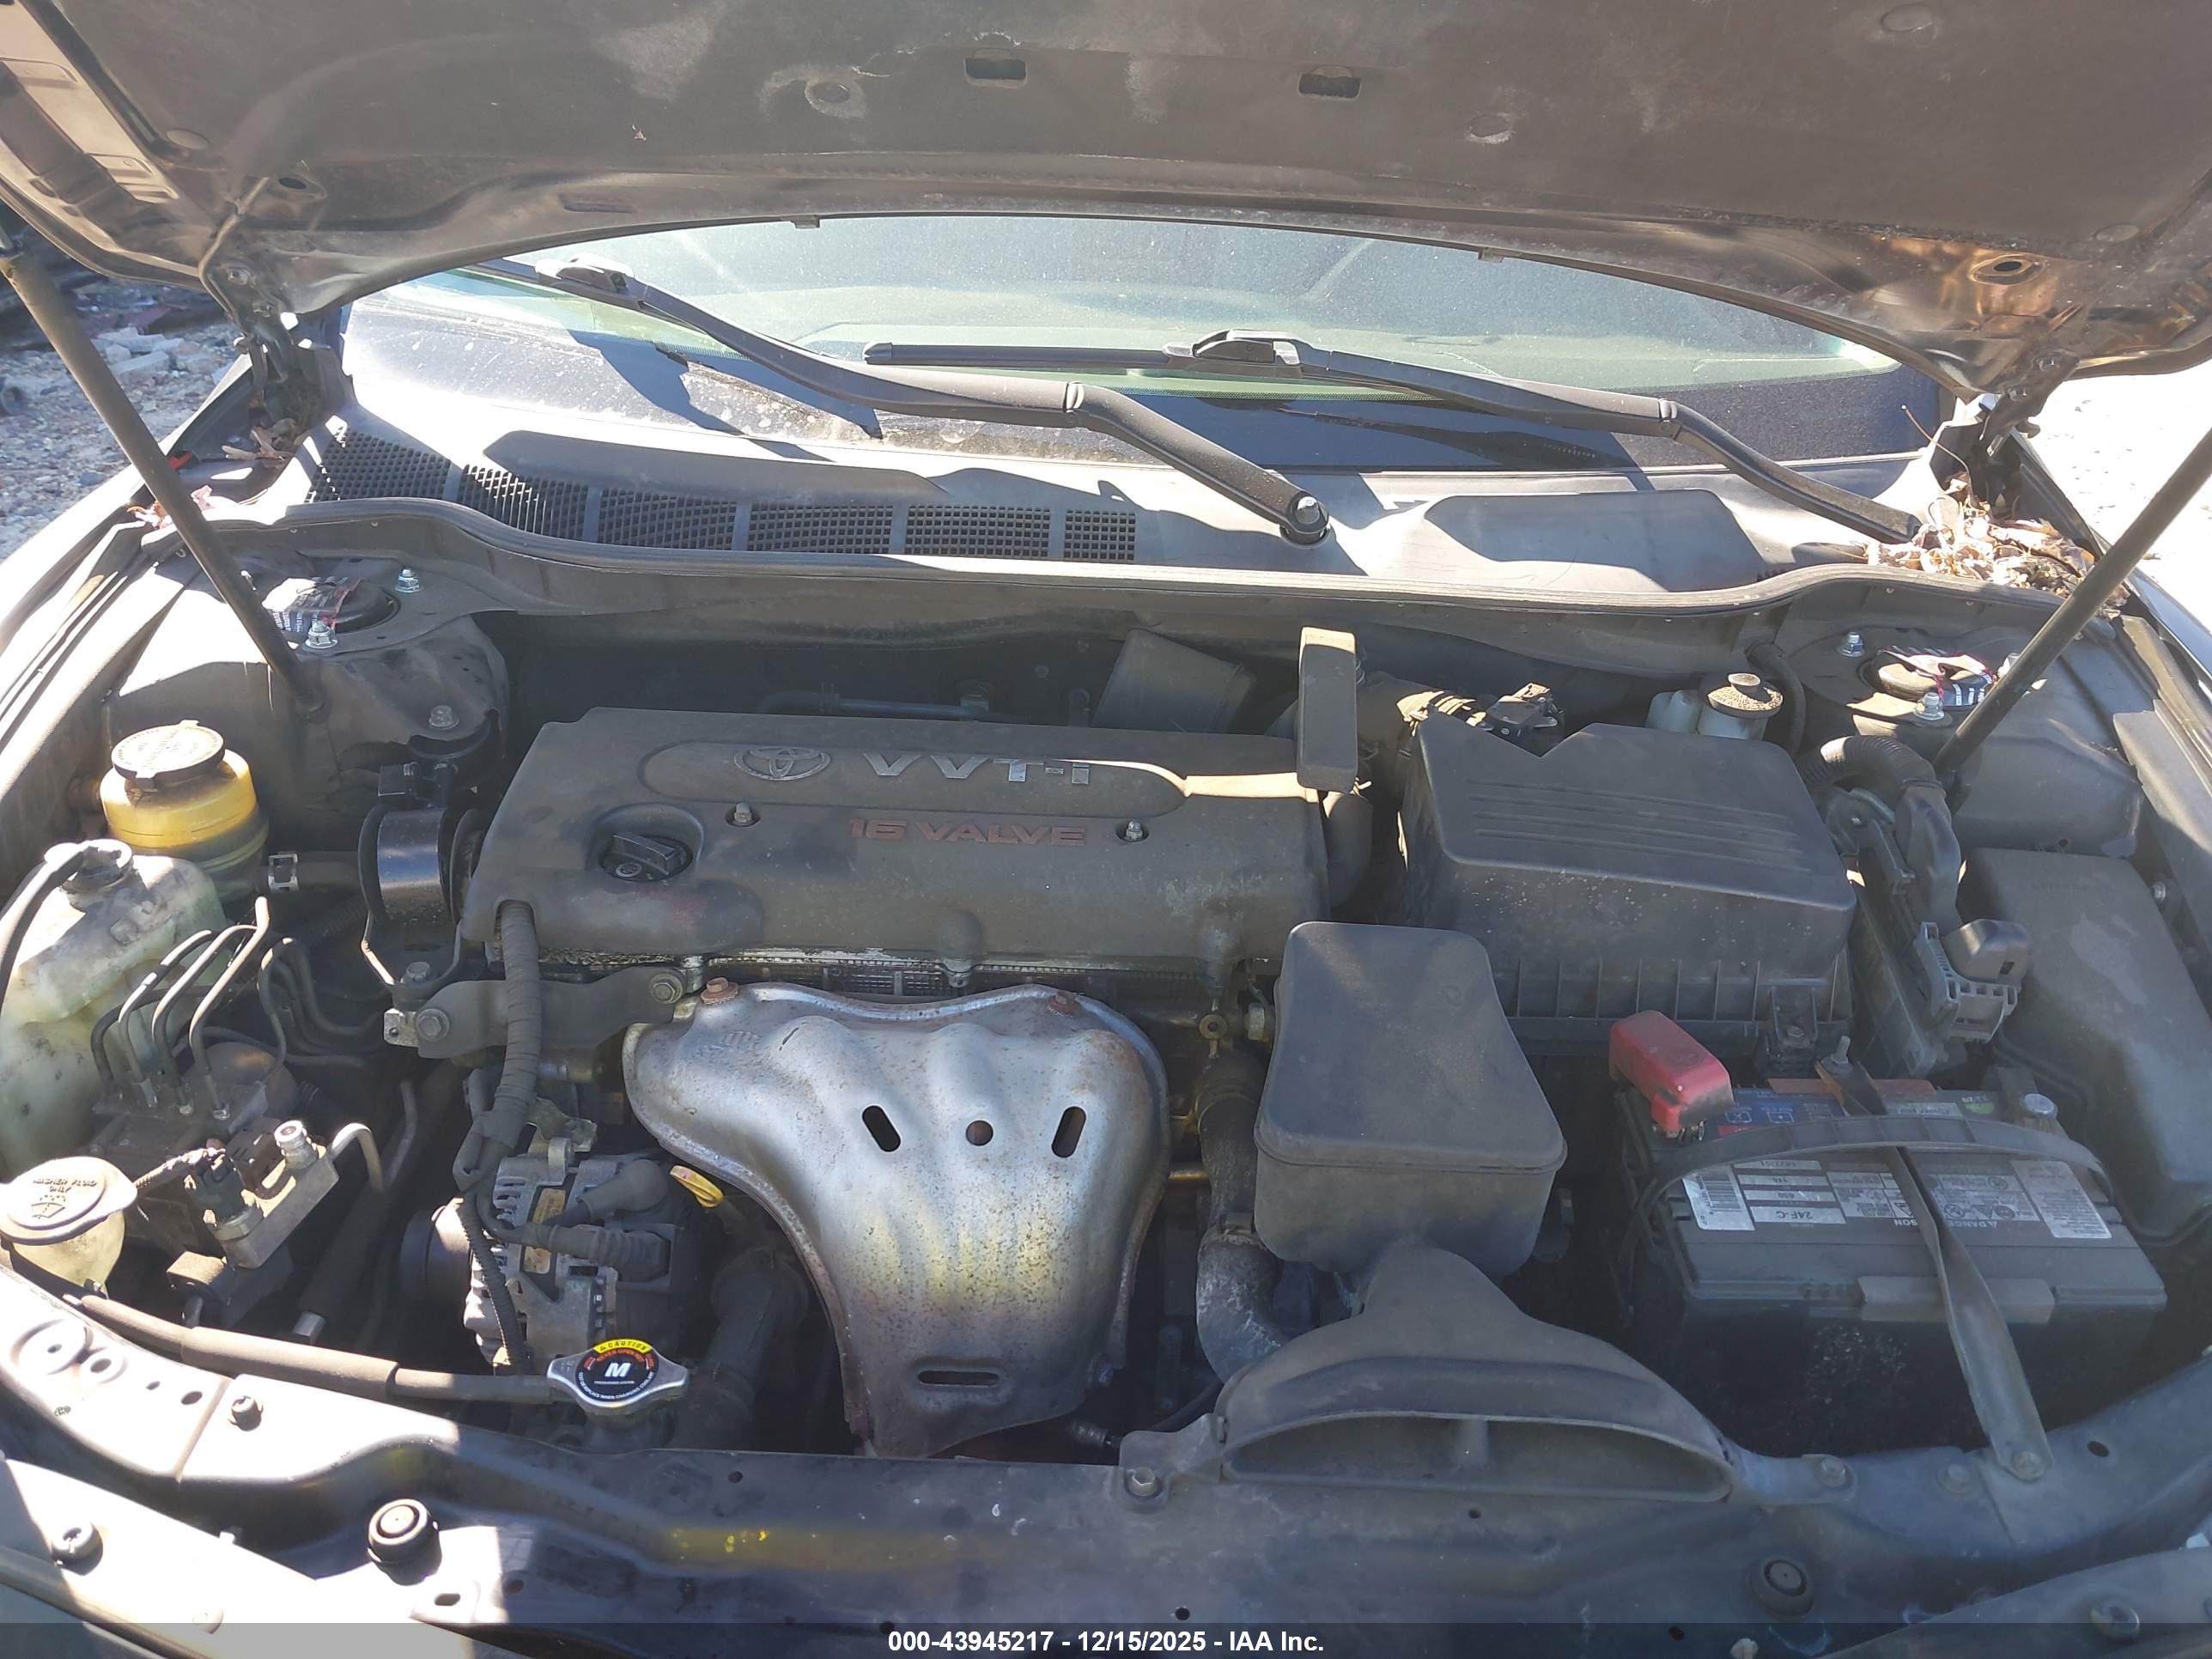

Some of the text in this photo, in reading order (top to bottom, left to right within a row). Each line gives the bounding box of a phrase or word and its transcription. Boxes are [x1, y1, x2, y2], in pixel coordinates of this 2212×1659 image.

[850, 818, 1085, 846] 16 VALVE
[607, 1340, 647, 1351] CAUTION
[605, 1362, 631, 1377] M
